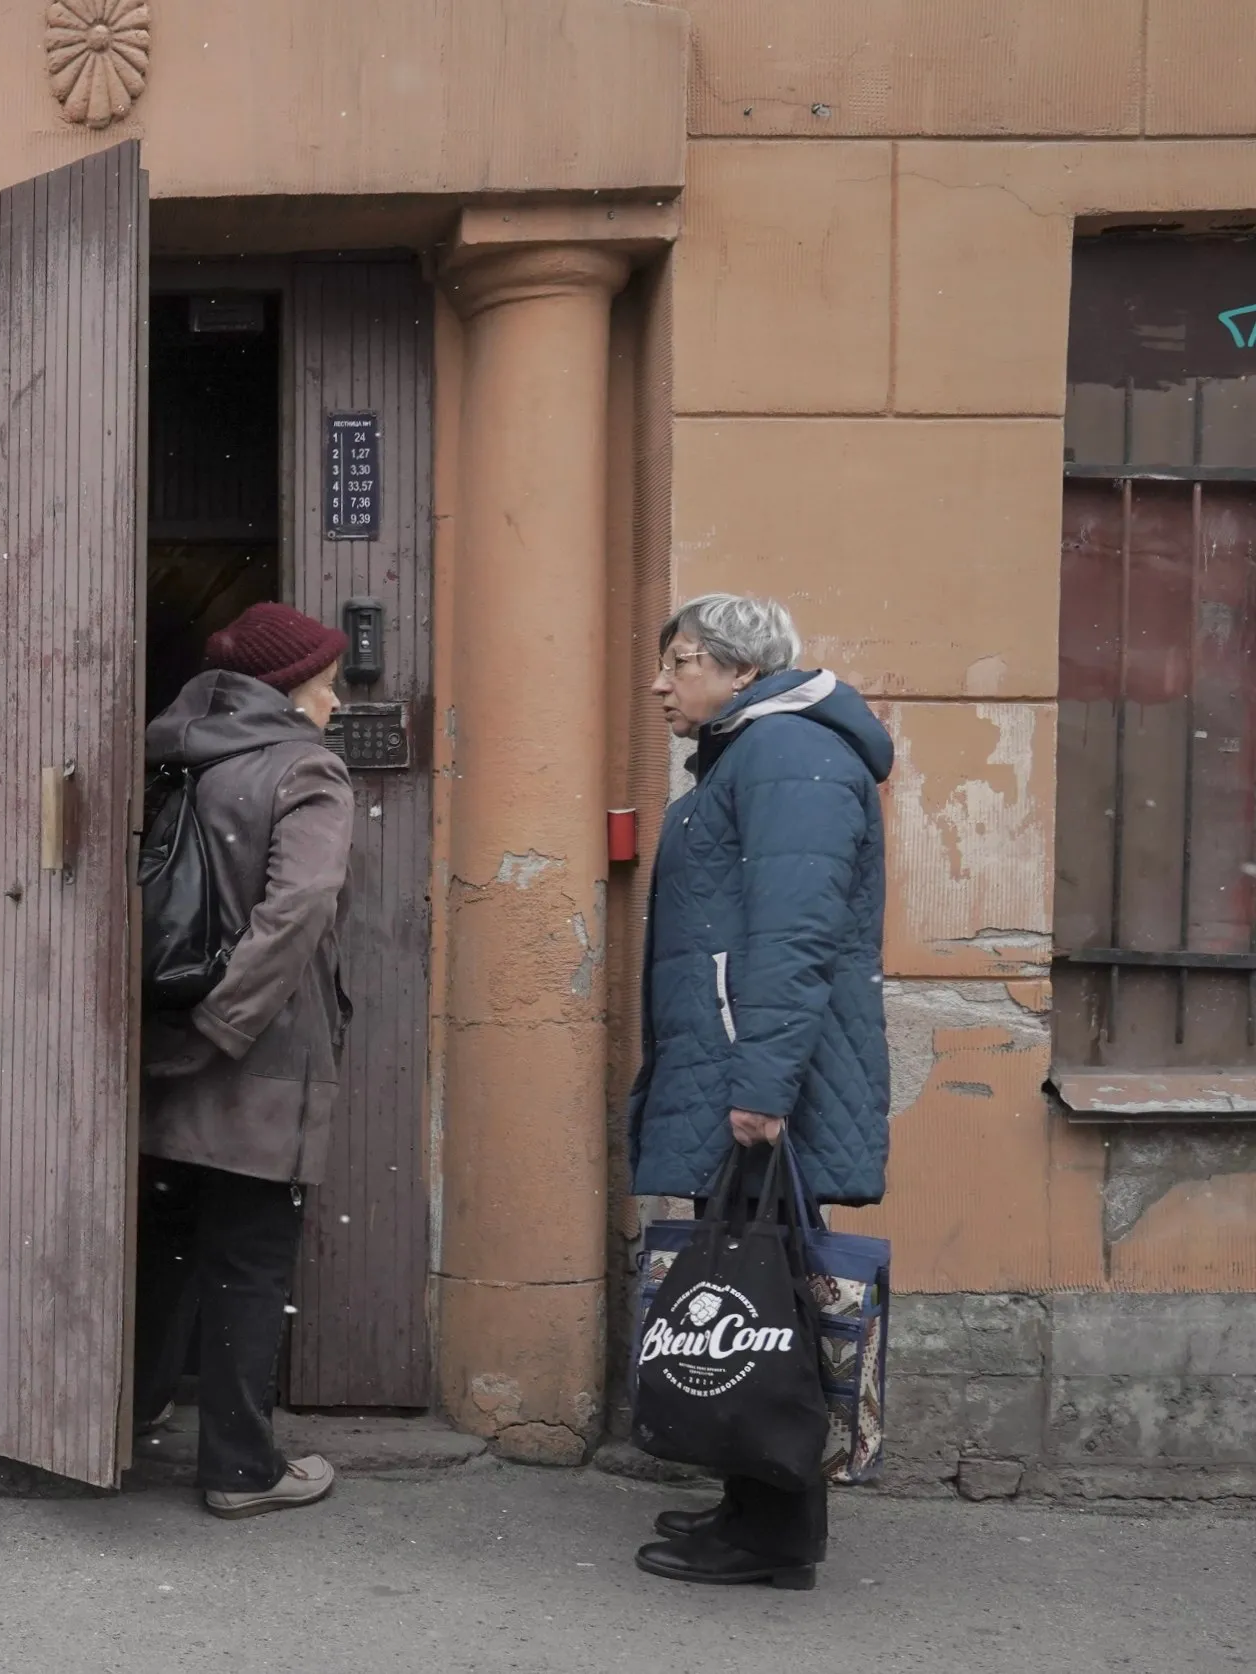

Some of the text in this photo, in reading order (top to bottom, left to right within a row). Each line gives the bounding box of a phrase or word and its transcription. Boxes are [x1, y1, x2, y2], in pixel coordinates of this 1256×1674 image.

[332, 432, 366, 443] 1 24
[332, 448, 370, 460] 2 1,27
[332, 465, 371, 476] 3 3,30
[332, 481, 373, 492] 4 33,57
[332, 497, 371, 509] 5 7,36
[332, 513, 371, 525] 6 9,39
[638, 1313, 794, 1366] BrewCom
